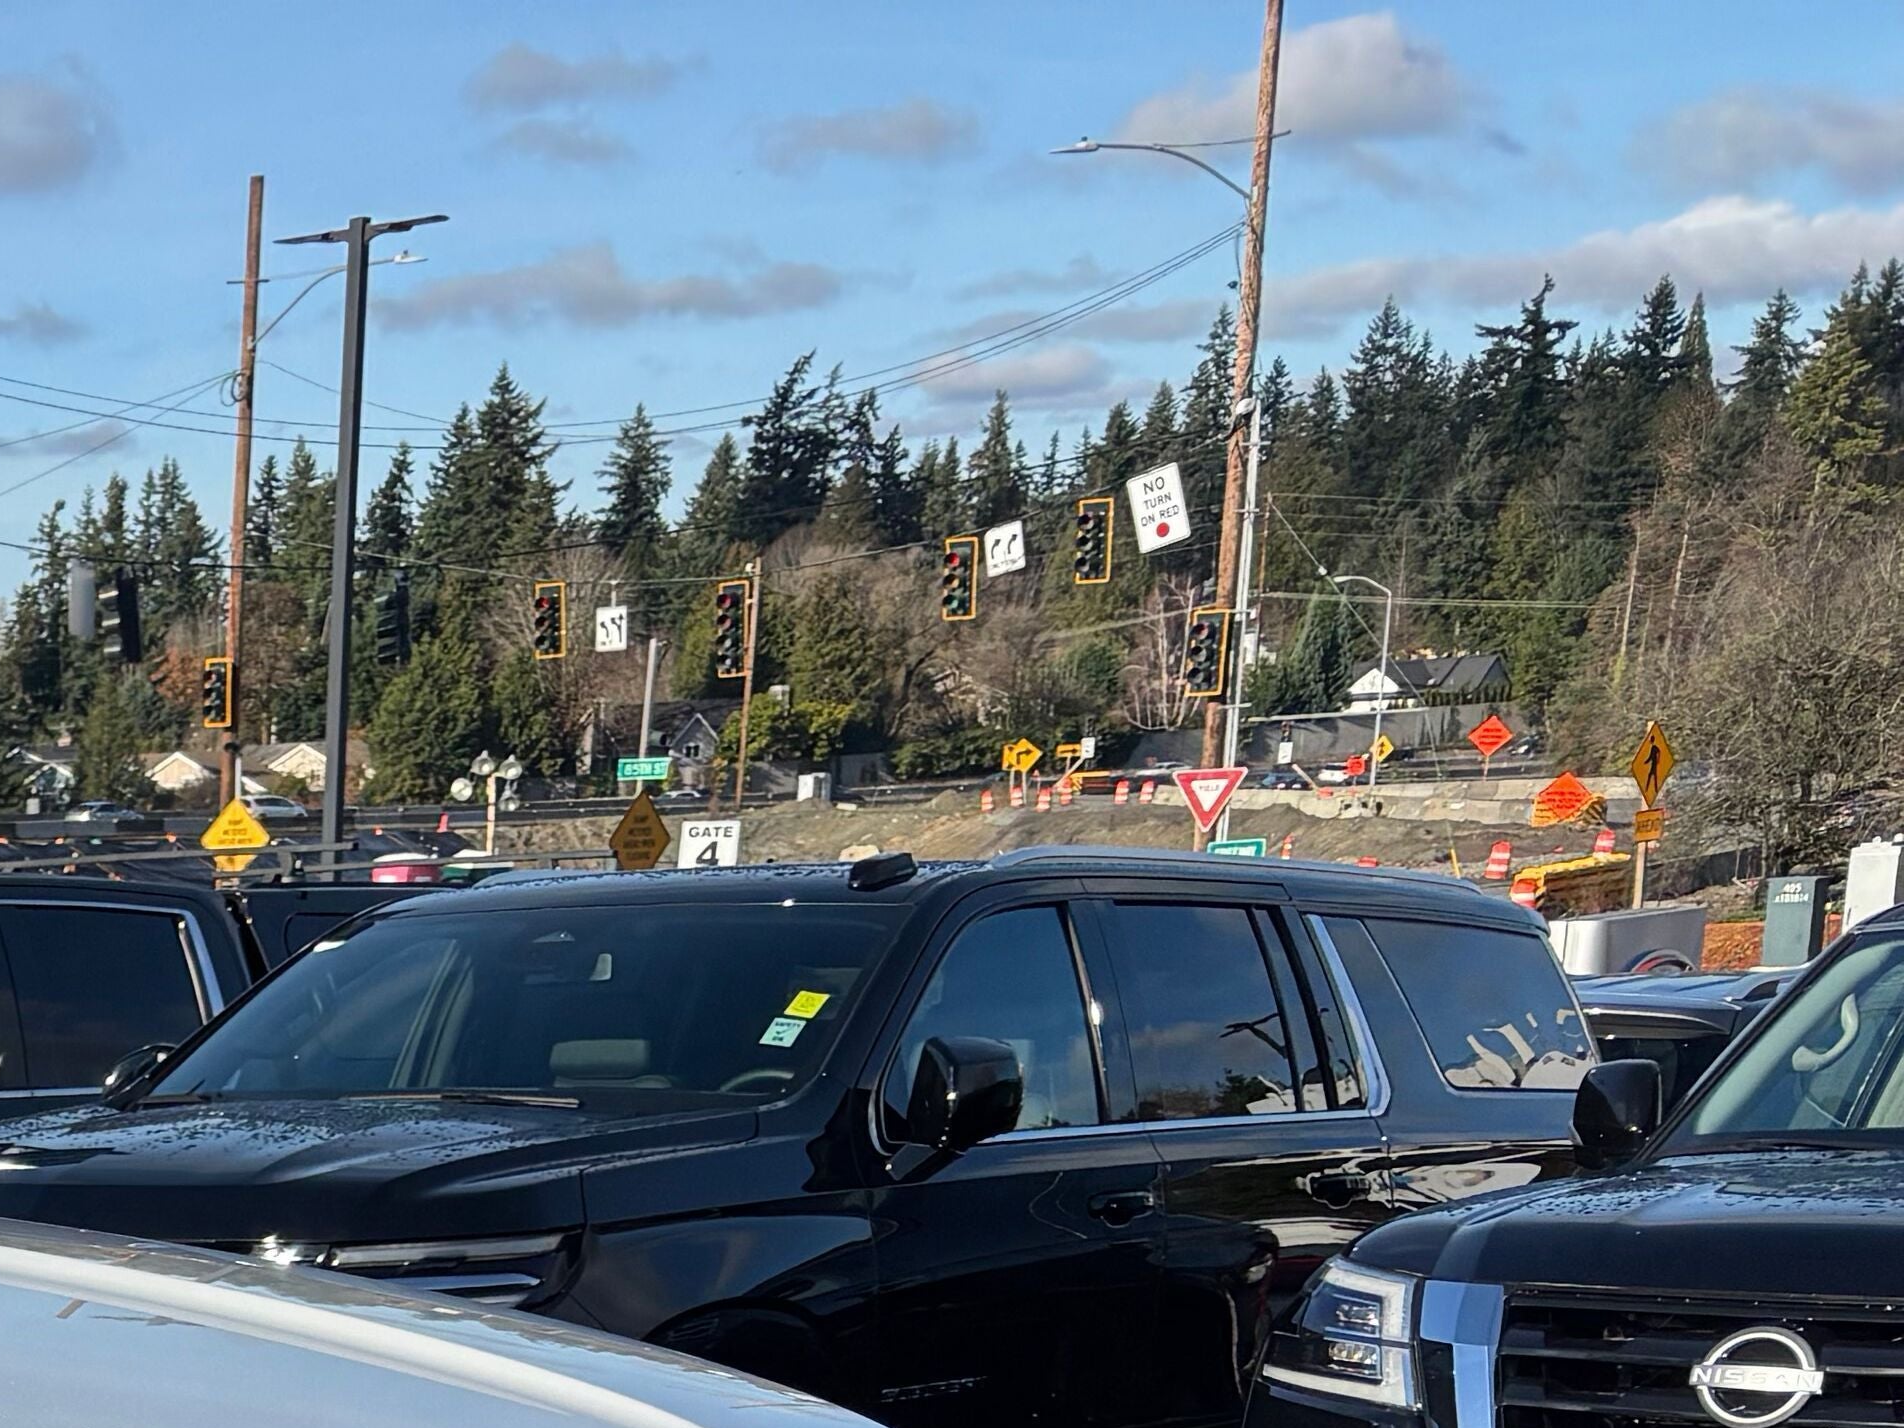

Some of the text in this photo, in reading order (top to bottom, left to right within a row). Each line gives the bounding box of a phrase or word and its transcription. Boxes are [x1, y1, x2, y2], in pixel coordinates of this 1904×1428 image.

[1143, 476, 1165, 495] NO
[1143, 492, 1172, 510] TURN
[1141, 504, 1179, 527] ON RED
[689, 826, 733, 838] GATE
[695, 841, 720, 866] 4
[1692, 1368, 1816, 1388] NISSAN
